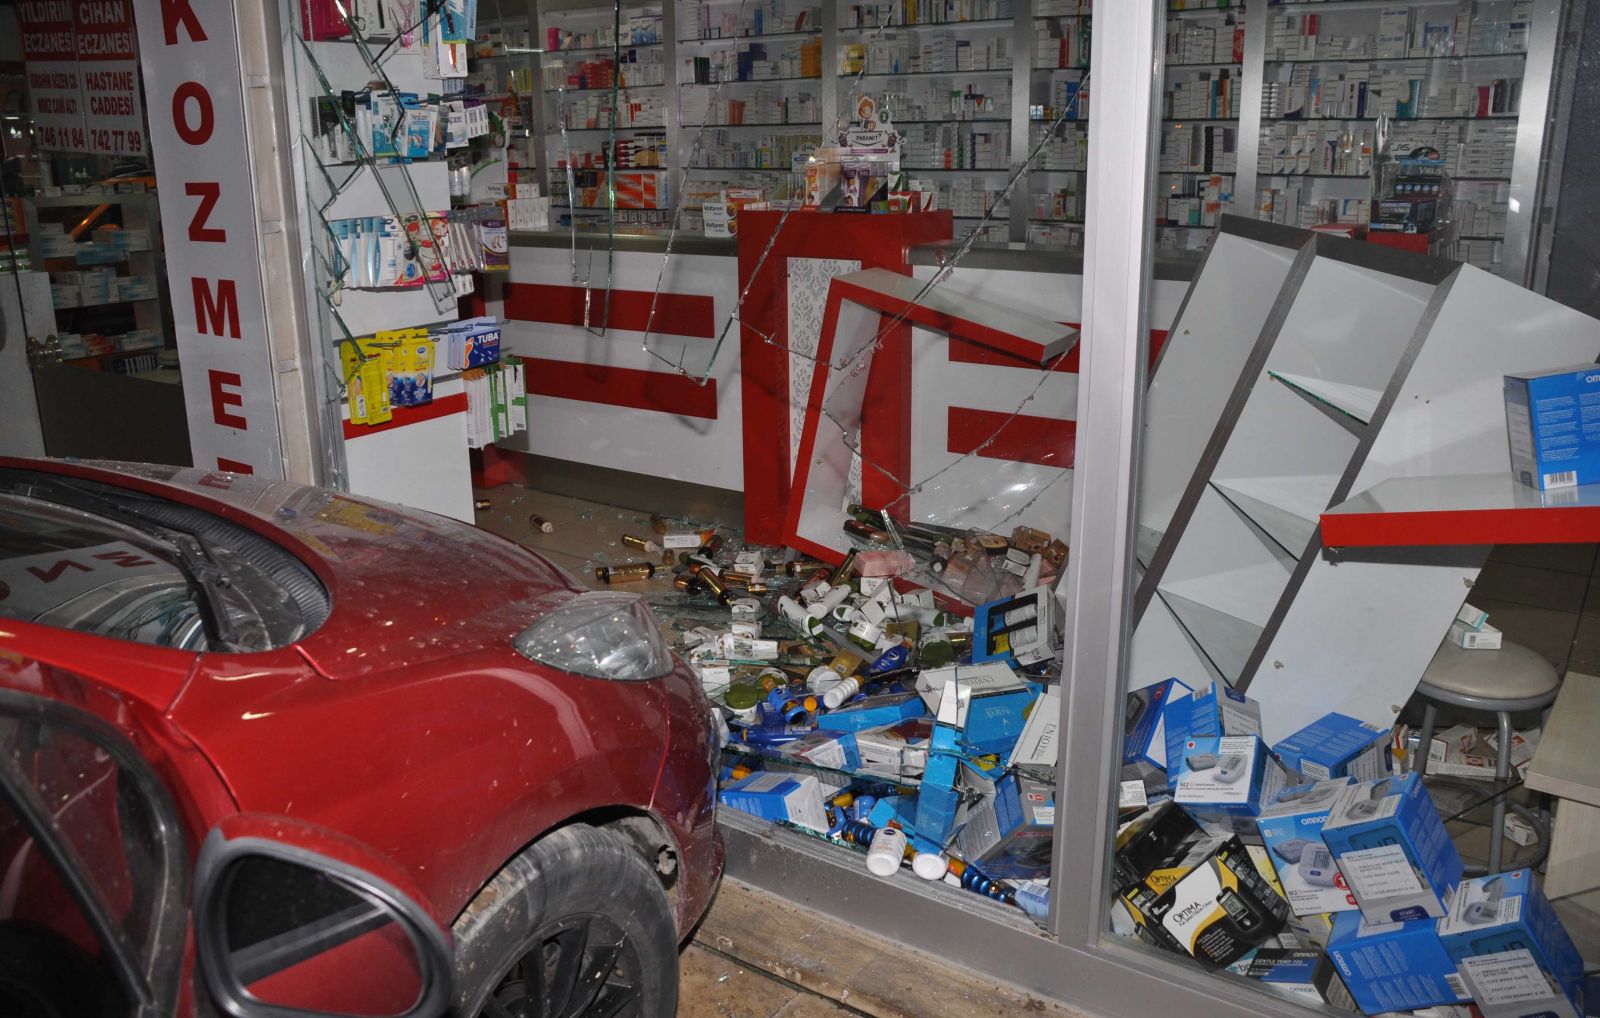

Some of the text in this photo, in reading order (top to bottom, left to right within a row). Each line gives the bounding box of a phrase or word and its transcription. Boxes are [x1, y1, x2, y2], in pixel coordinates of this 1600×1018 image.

[78, 27, 134, 54] ECZANESİ
[85, 71, 134, 91] HASTANE
[91, 92, 135, 115] CADDESİ
[38, 126, 84, 148] 746 11 84
[91, 129, 141, 152] 742 77 99
[160, 0, 254, 474] KOZME
[478, 331, 500, 344] TUBA
[1172, 901, 1202, 923] OPTIMA
